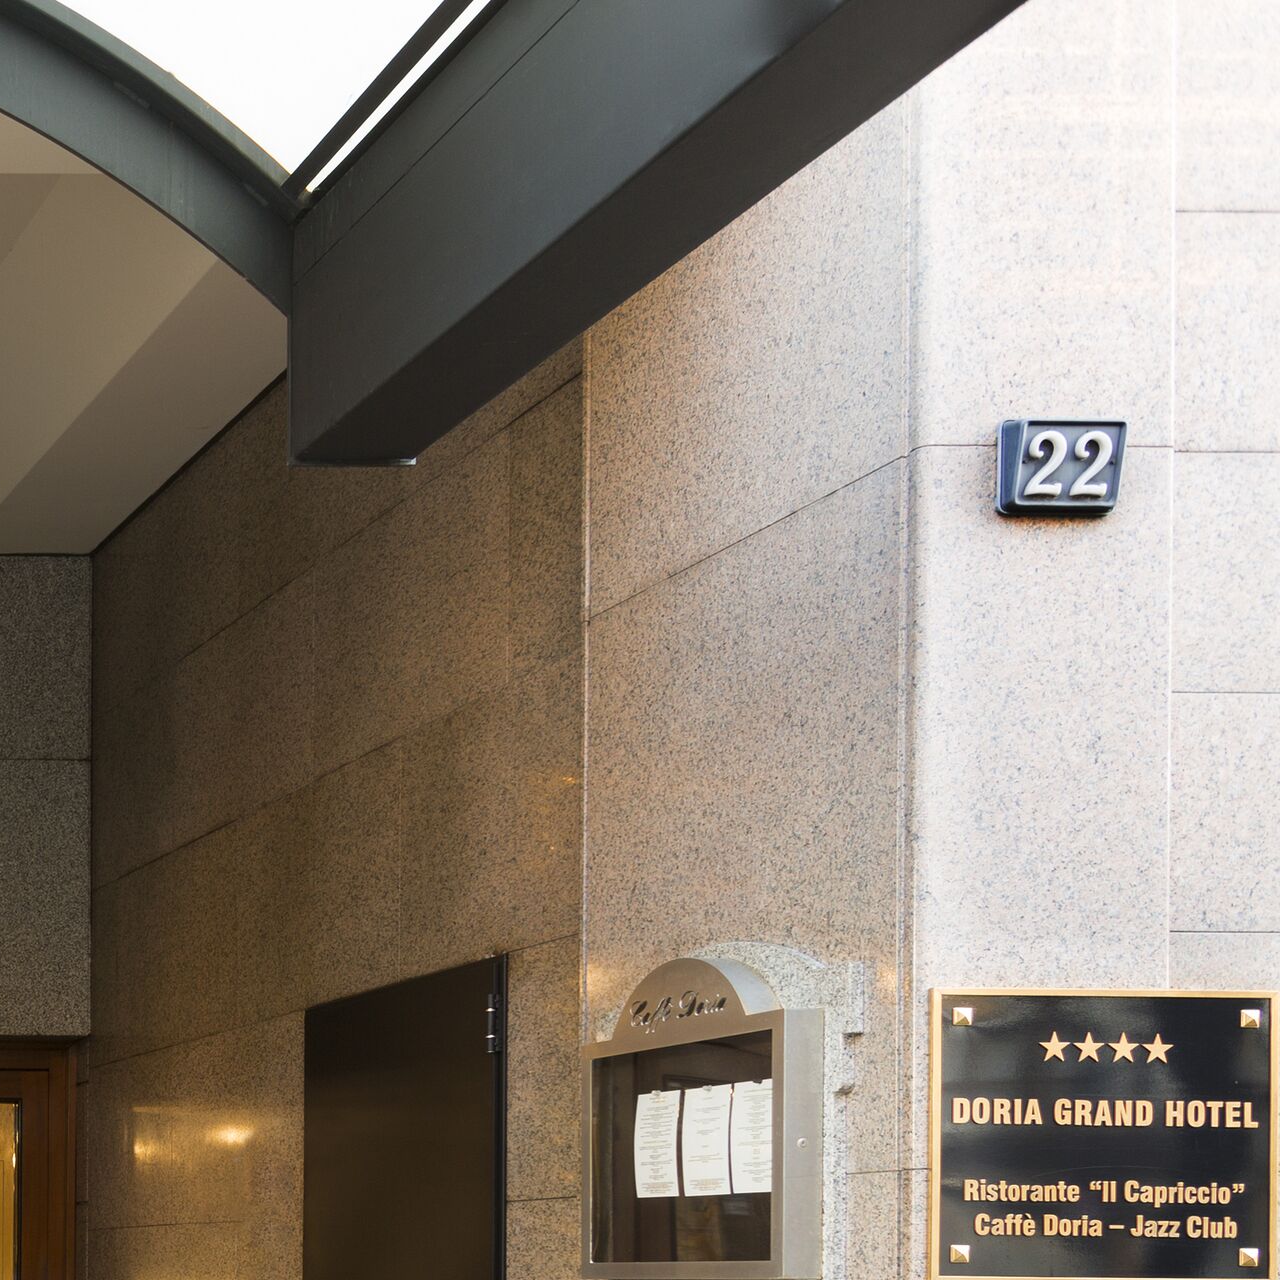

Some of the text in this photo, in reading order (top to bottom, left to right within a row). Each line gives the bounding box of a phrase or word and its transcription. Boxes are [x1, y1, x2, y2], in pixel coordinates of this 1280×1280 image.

[1024, 430, 1113, 498] 22
[676, 990, 727, 1016] Doria
[952, 1097, 1259, 1129] DORIA GRAND HOTEL
[964, 1179, 1080, 1203] Ristorante
[974, 1213, 1037, 1237] Caffè
[1043, 1214, 1103, 1236] Doria
[1130, 1215, 1181, 1238] Jazz
[1186, 1216, 1239, 1239] Club
